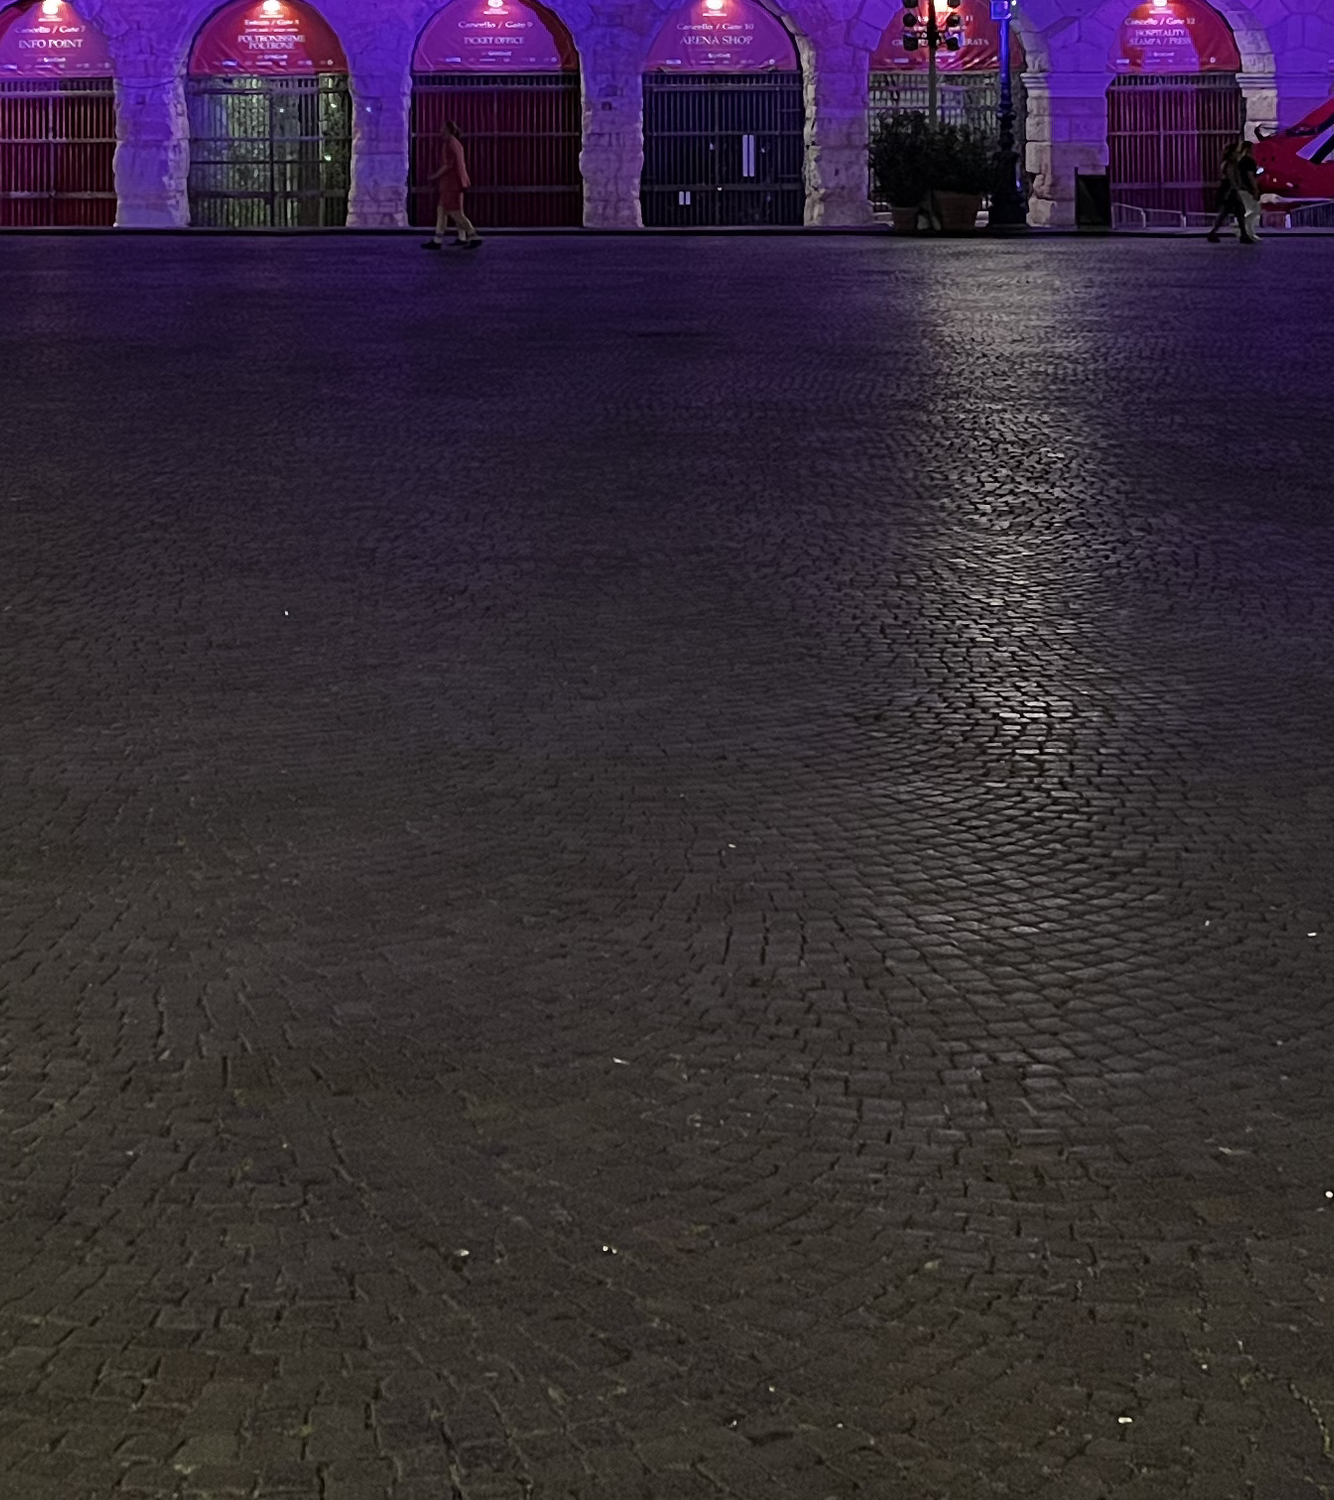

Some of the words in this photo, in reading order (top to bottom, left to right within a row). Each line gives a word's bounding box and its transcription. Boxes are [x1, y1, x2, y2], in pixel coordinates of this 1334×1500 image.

[505, 21, 526, 29] Gate
[1165, 17, 1185, 25] Gate
[59, 25, 80, 34] Gate
[1134, 29, 1185, 37] HOSPITALITY
[18, 39, 47, 49] INFO
[48, 39, 83, 49] POINT
[463, 36, 494, 45] TICKET
[494, 36, 525, 45] OFFICE
[679, 36, 721, 45] ARENA
[722, 35, 754, 45] SHOP
[1129, 37, 1162, 46] STAMPA
[1168, 37, 1192, 46] PRESS
